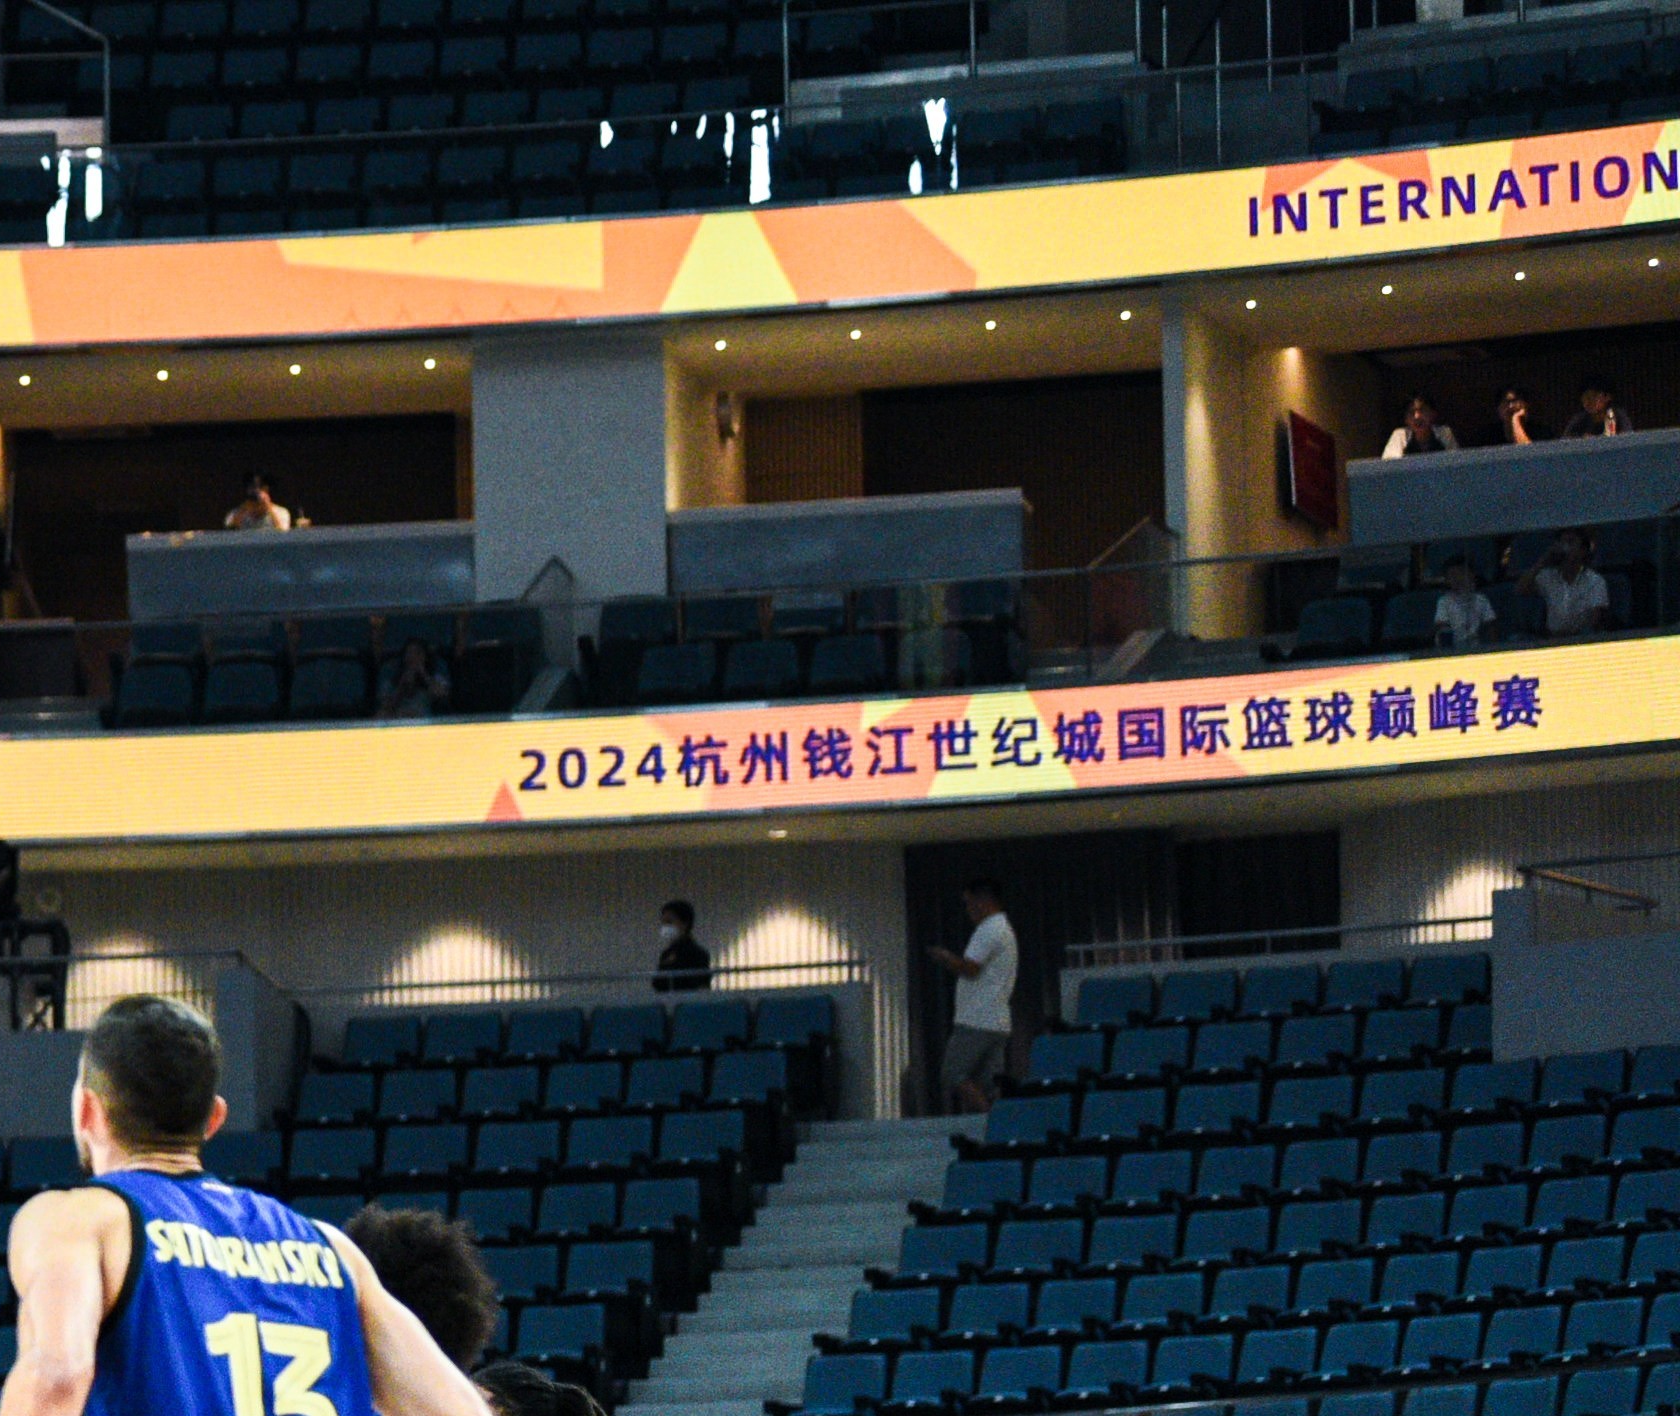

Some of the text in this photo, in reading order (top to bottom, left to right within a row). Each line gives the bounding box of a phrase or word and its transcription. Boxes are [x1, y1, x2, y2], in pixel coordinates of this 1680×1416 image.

[1248, 149, 1680, 237] INTERNATION
[519, 673, 1544, 791] 2024杭州钱江世纪城国际篮球巅峰赛
